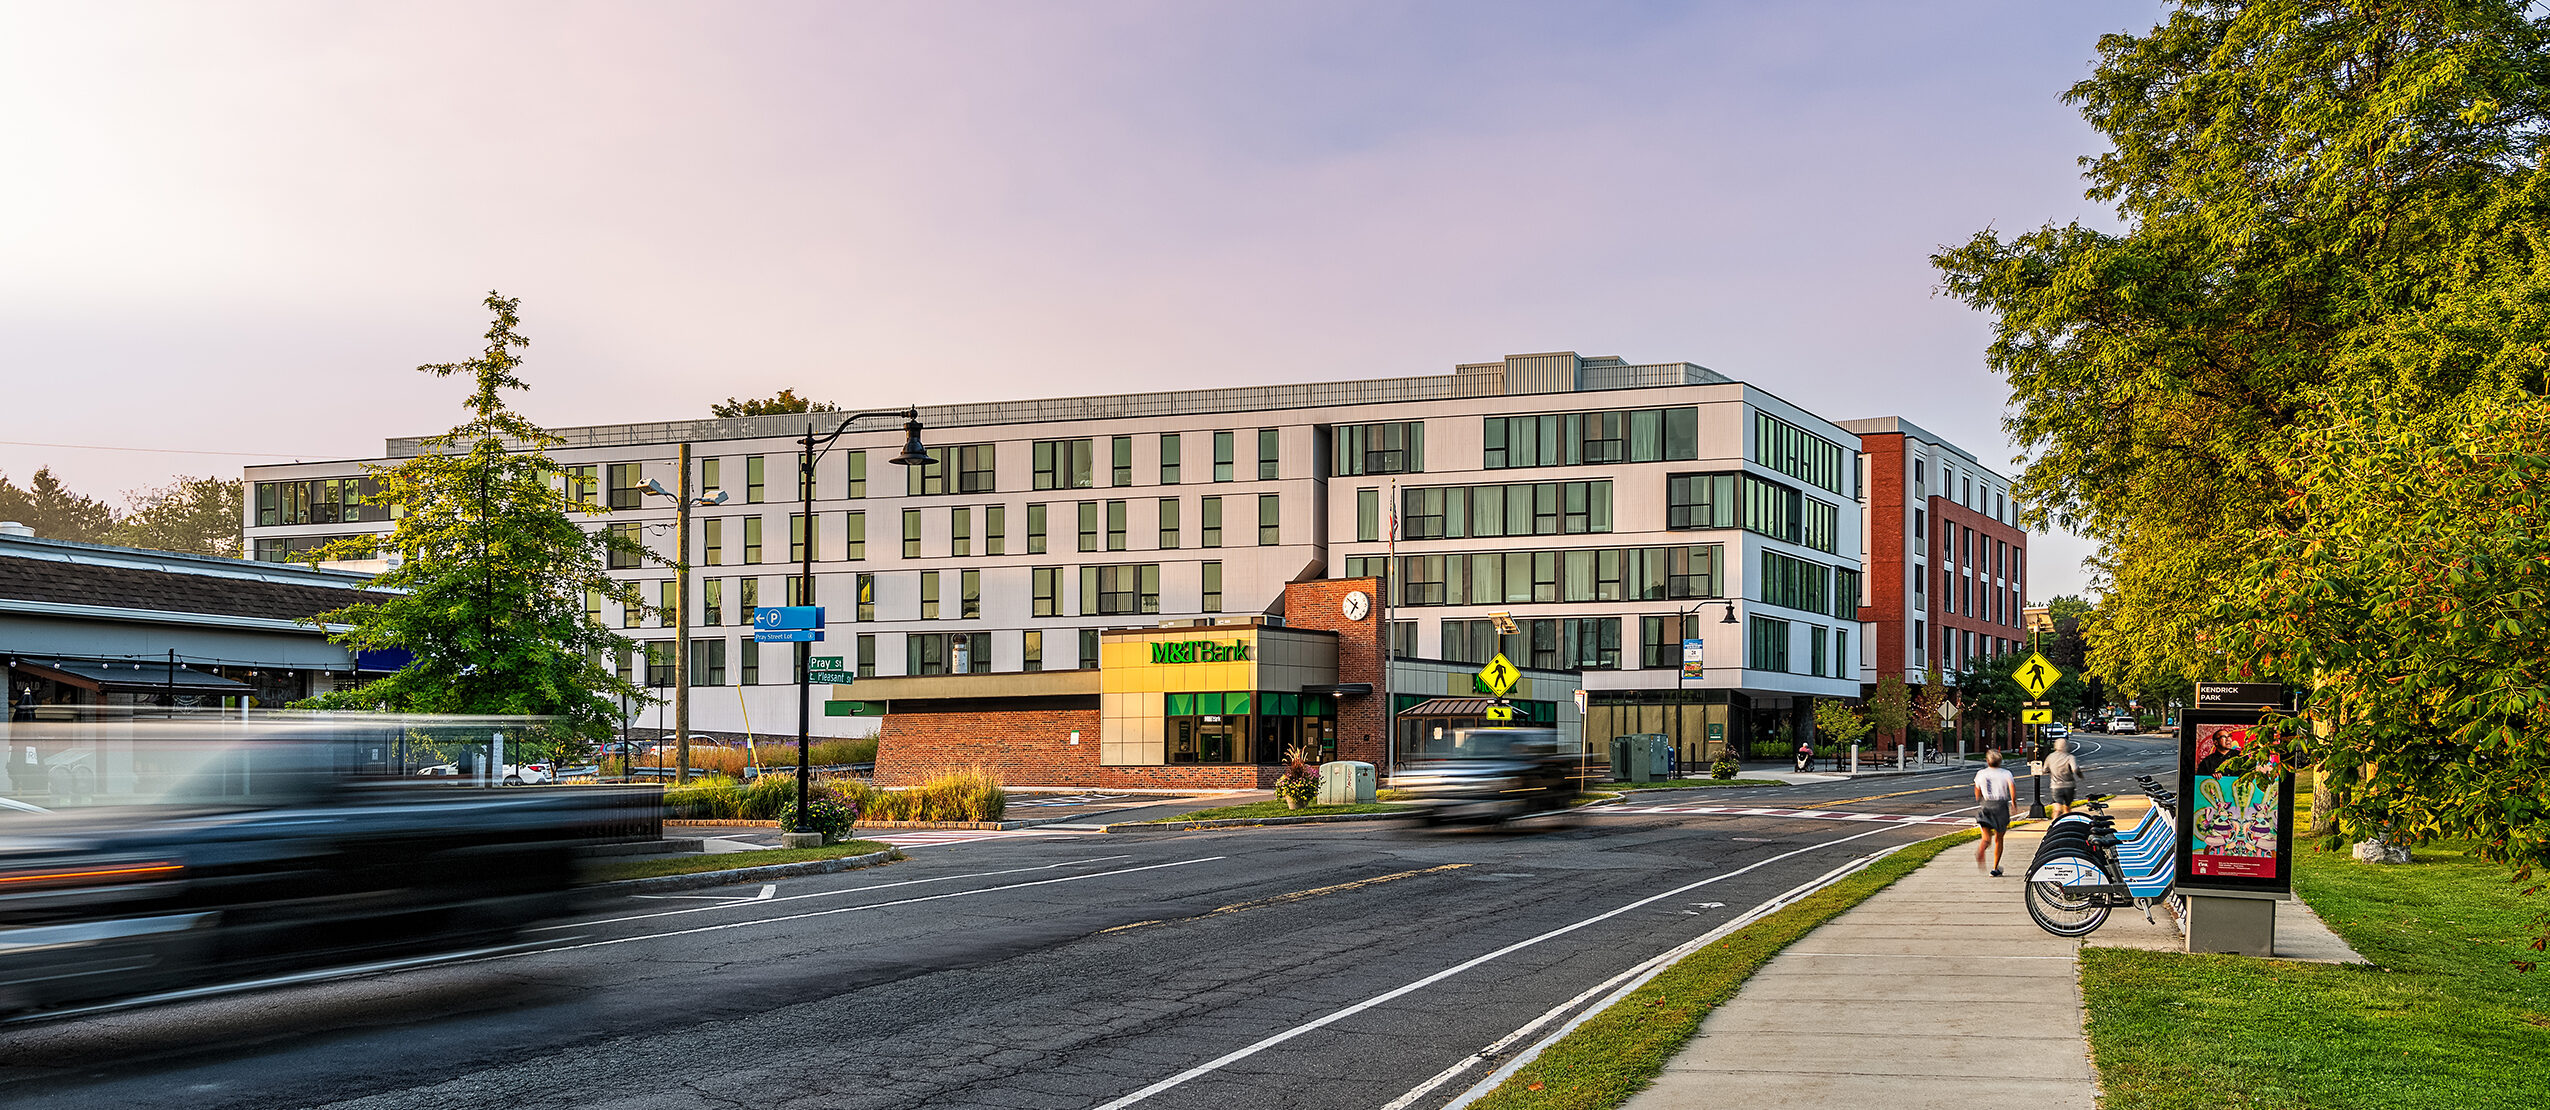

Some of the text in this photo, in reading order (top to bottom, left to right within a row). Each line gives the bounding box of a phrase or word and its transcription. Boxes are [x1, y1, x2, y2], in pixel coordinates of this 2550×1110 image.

[811, 658, 842, 669] Pray St
[817, 671, 845, 683] Pleasant
